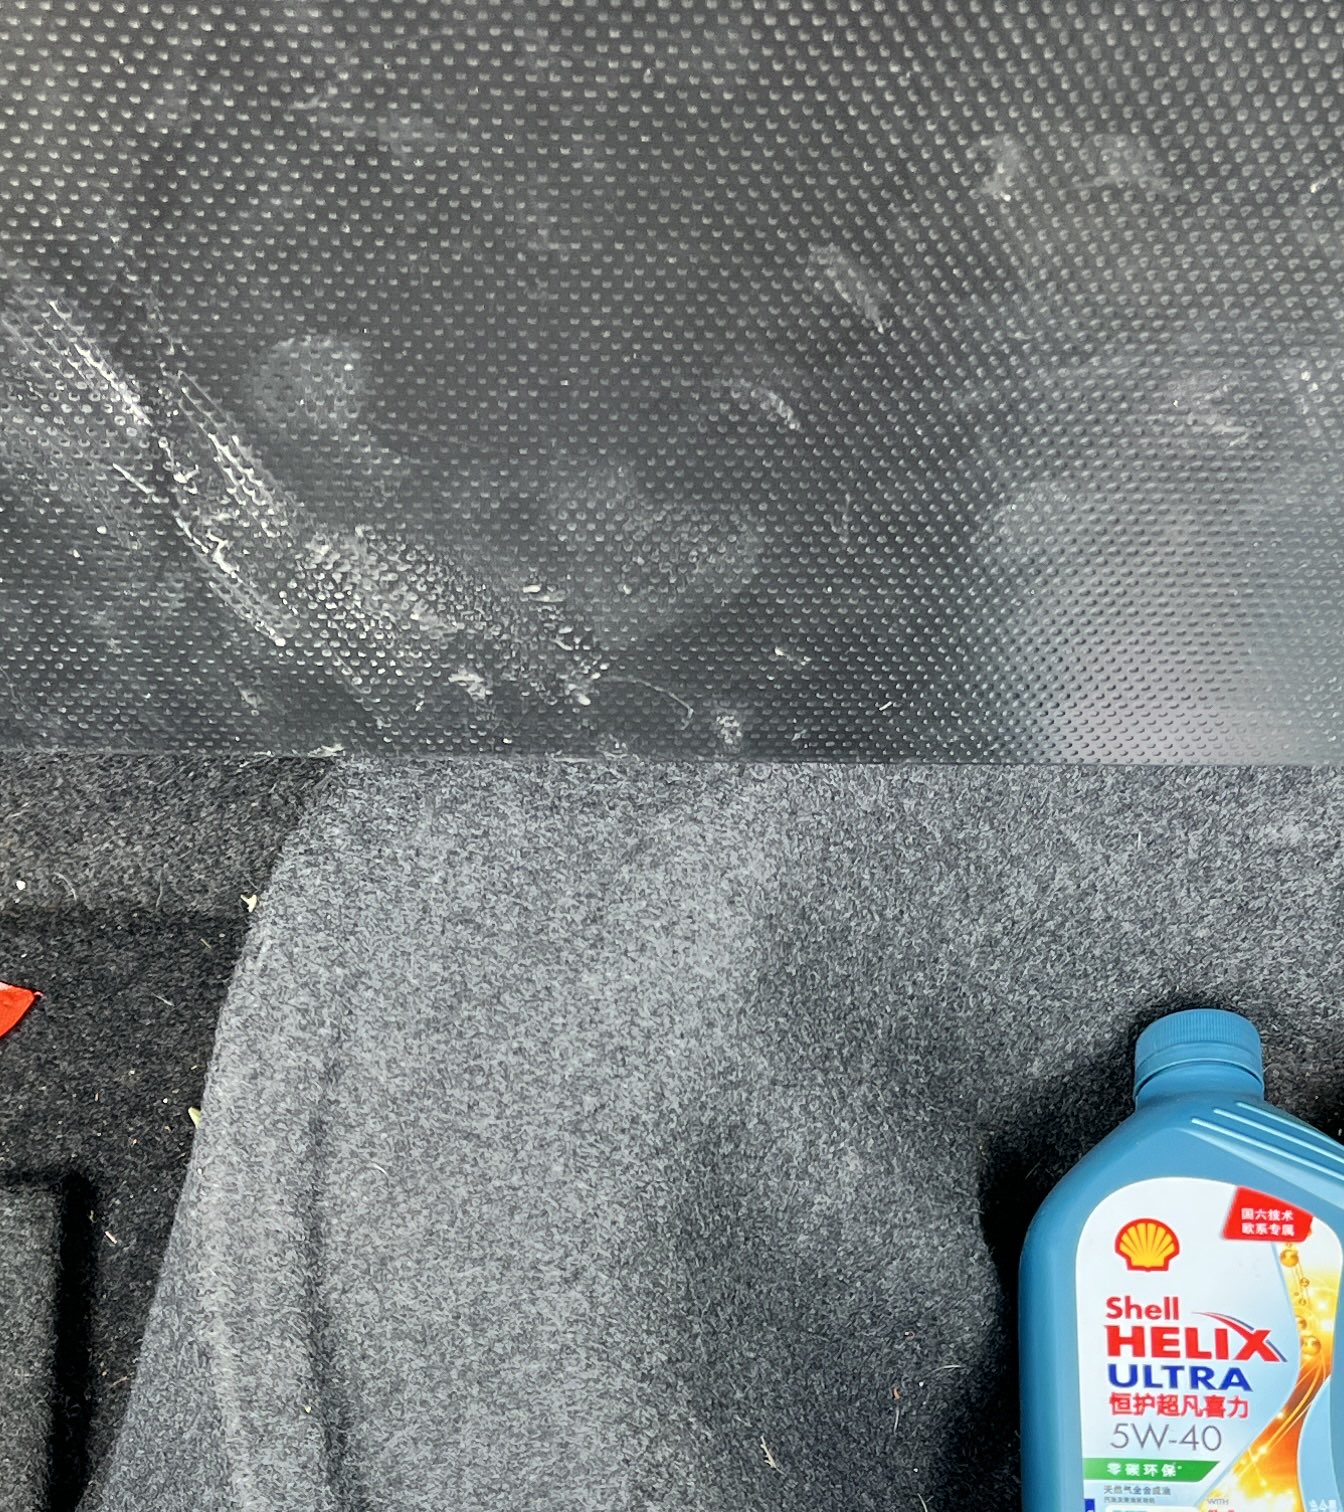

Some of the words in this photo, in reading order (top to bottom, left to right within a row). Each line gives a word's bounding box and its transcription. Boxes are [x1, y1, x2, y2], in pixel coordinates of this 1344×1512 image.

[1241, 1208, 1294, 1221] 国六技术
[1105, 1296, 1179, 1320] Shell
[1104, 1316, 1283, 1362] HELIX
[1108, 1363, 1253, 1392] ULTRA
[1109, 1392, 1249, 1419] 恒护超凡喜力
[1110, 1422, 1222, 1451] 5W-40
